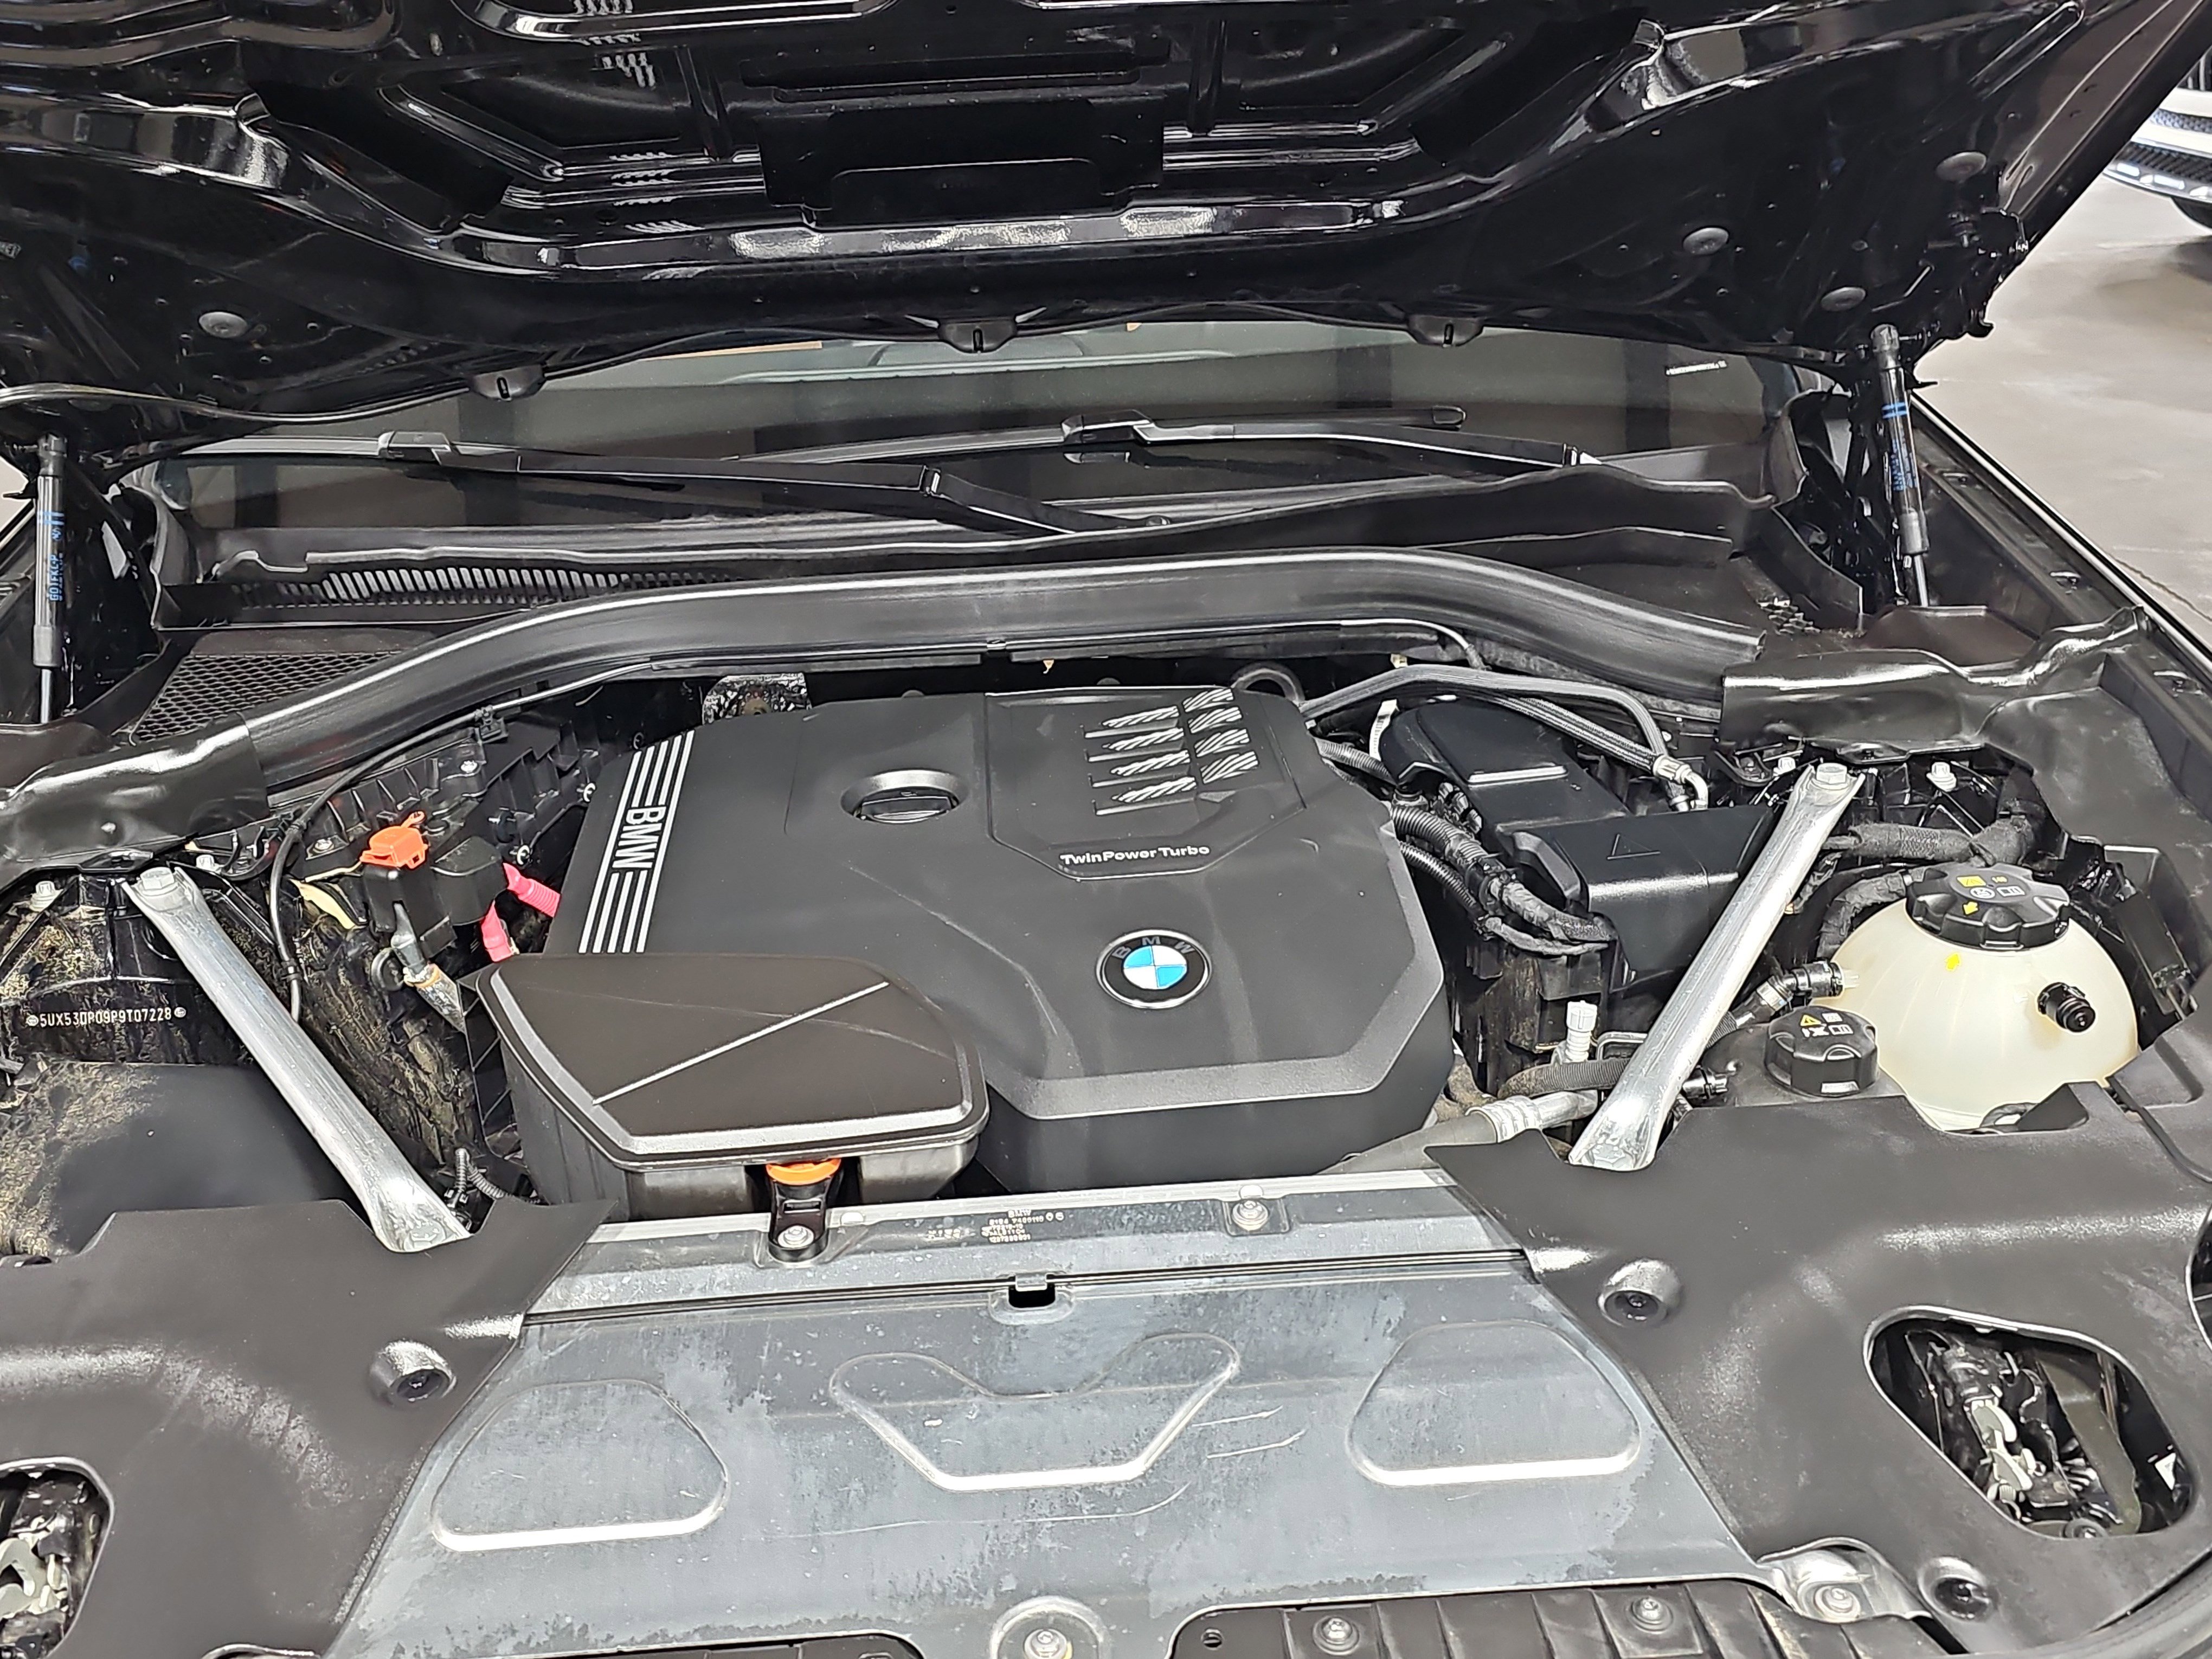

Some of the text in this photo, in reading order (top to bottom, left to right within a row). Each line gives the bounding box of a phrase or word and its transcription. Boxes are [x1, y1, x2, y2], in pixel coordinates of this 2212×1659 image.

[612, 806, 666, 869] BMW
[1060, 846, 1210, 865] TwinPower Turbo
[1111, 936, 1195, 959] BMW
